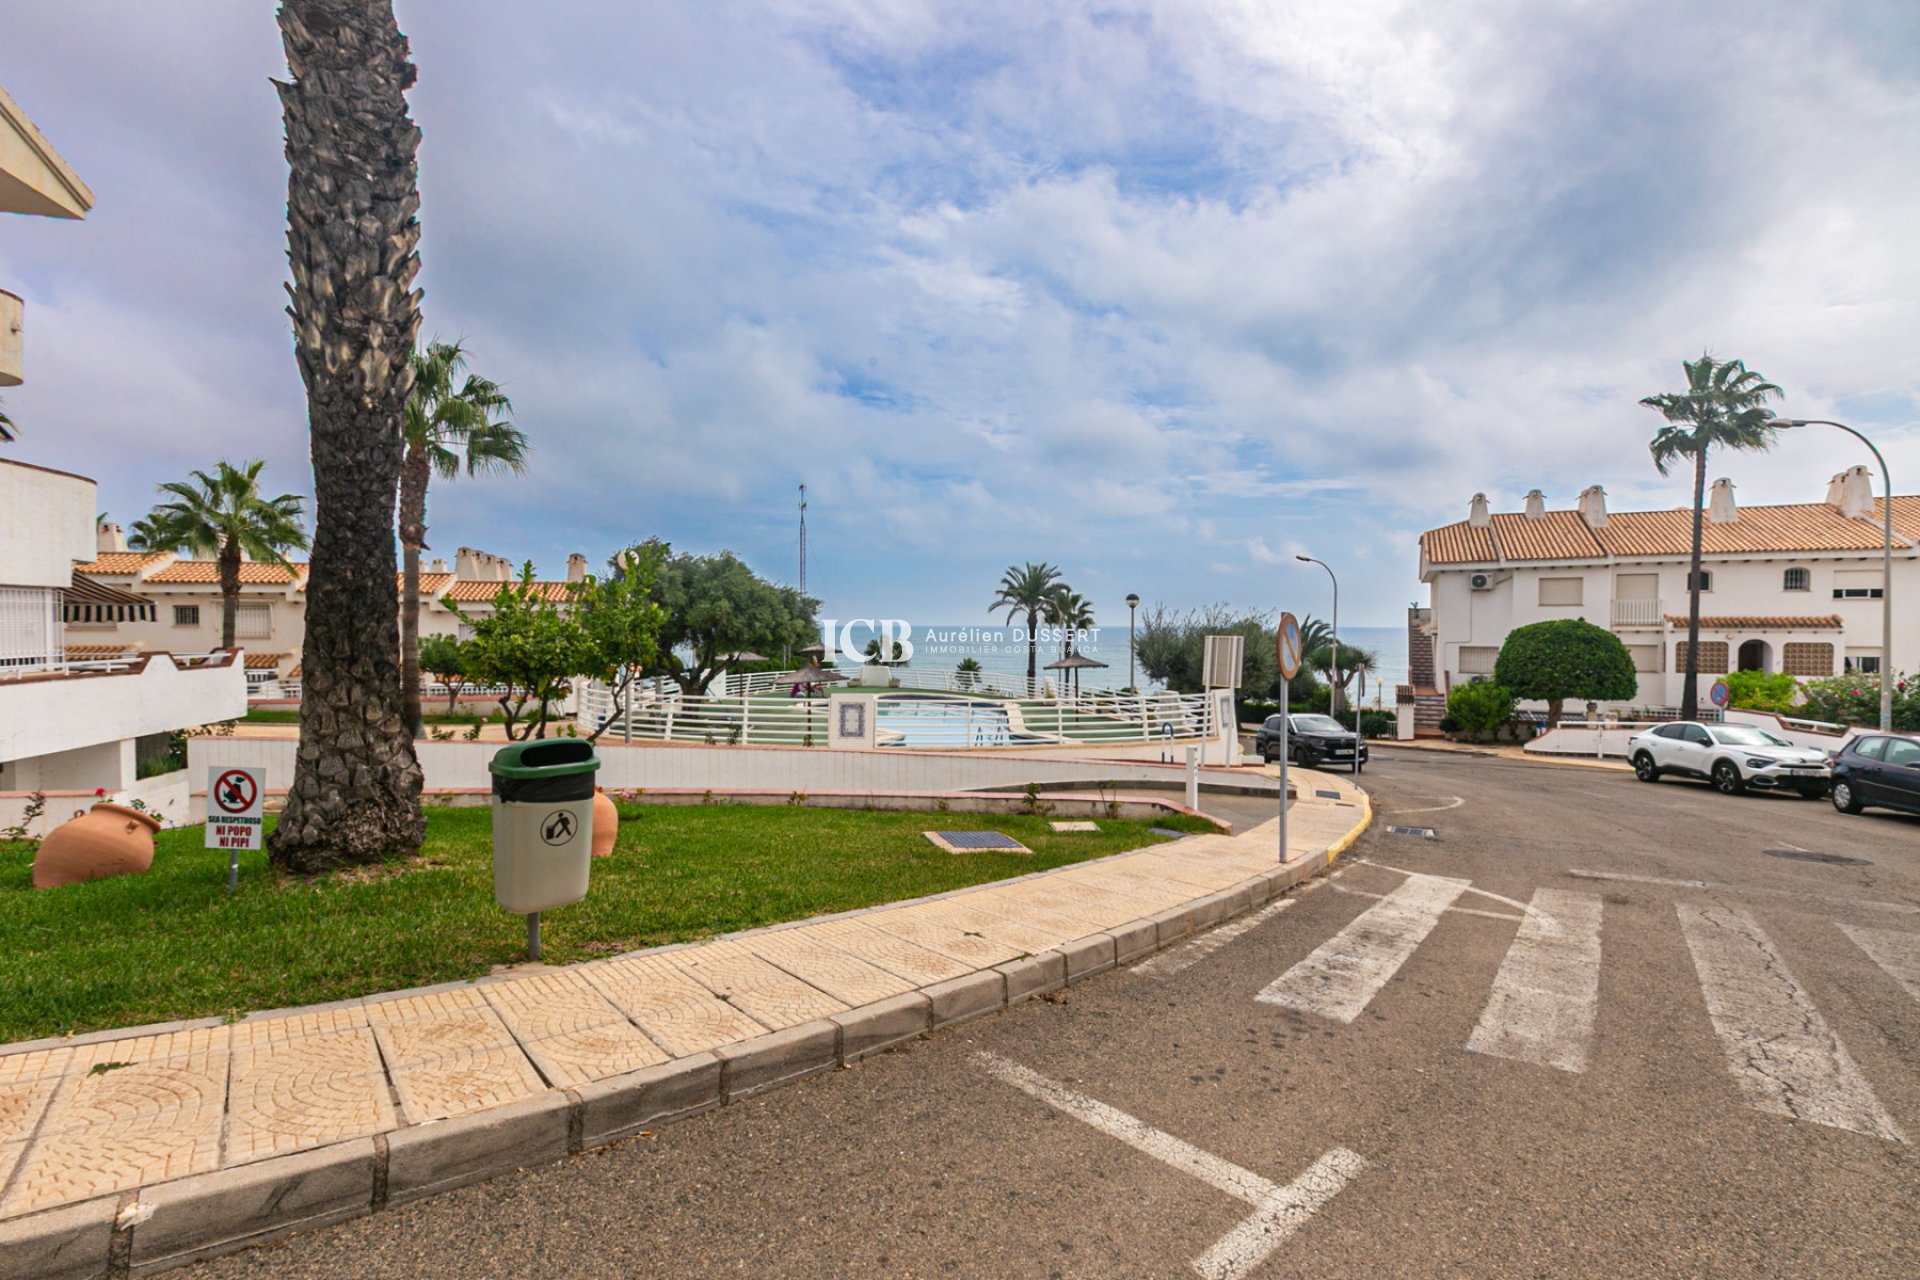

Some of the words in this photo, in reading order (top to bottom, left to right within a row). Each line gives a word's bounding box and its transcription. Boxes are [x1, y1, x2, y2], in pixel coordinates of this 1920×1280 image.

[215, 825, 226, 836] NI
[227, 826, 252, 837] POPO
[219, 837, 229, 848] NI
[231, 837, 250, 848] PIPI
